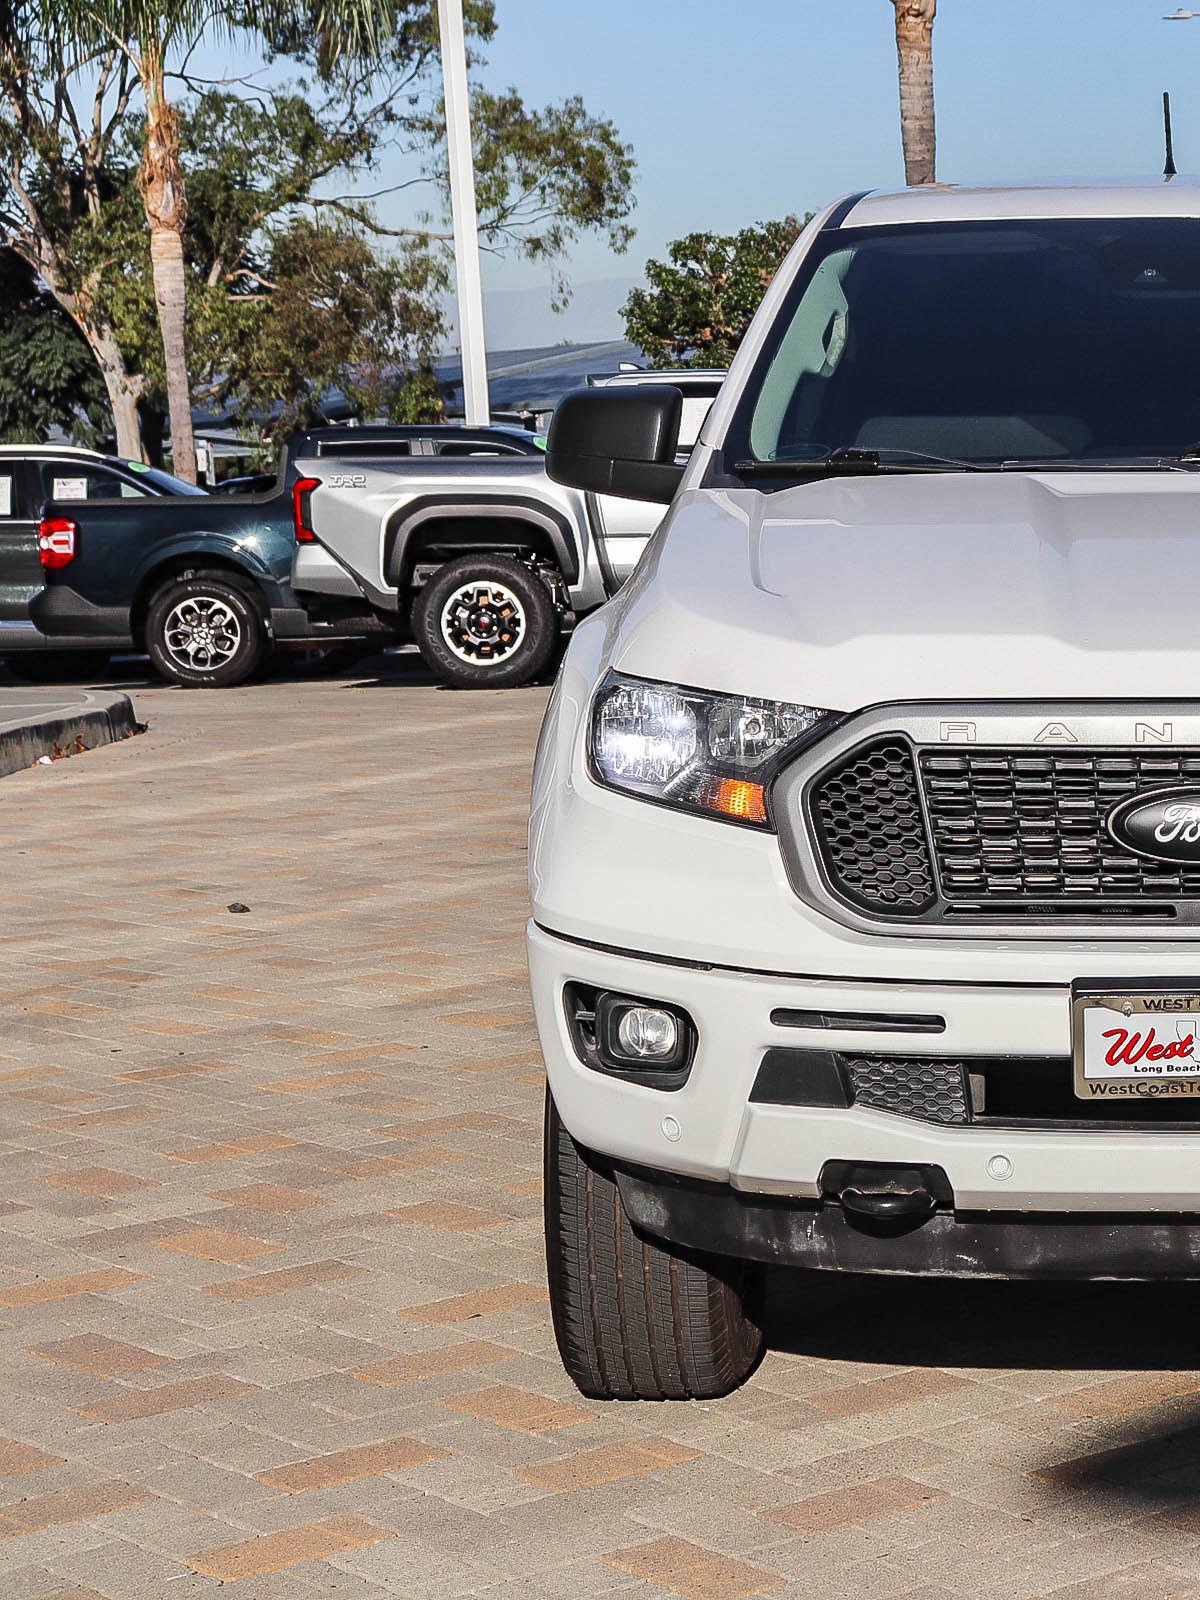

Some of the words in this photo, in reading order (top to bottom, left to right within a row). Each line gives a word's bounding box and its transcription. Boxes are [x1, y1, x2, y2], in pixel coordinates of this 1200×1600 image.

[1143, 998, 1196, 1010] WEST
[1102, 1027, 1194, 1066] West
[1133, 1064, 1165, 1074] Long
